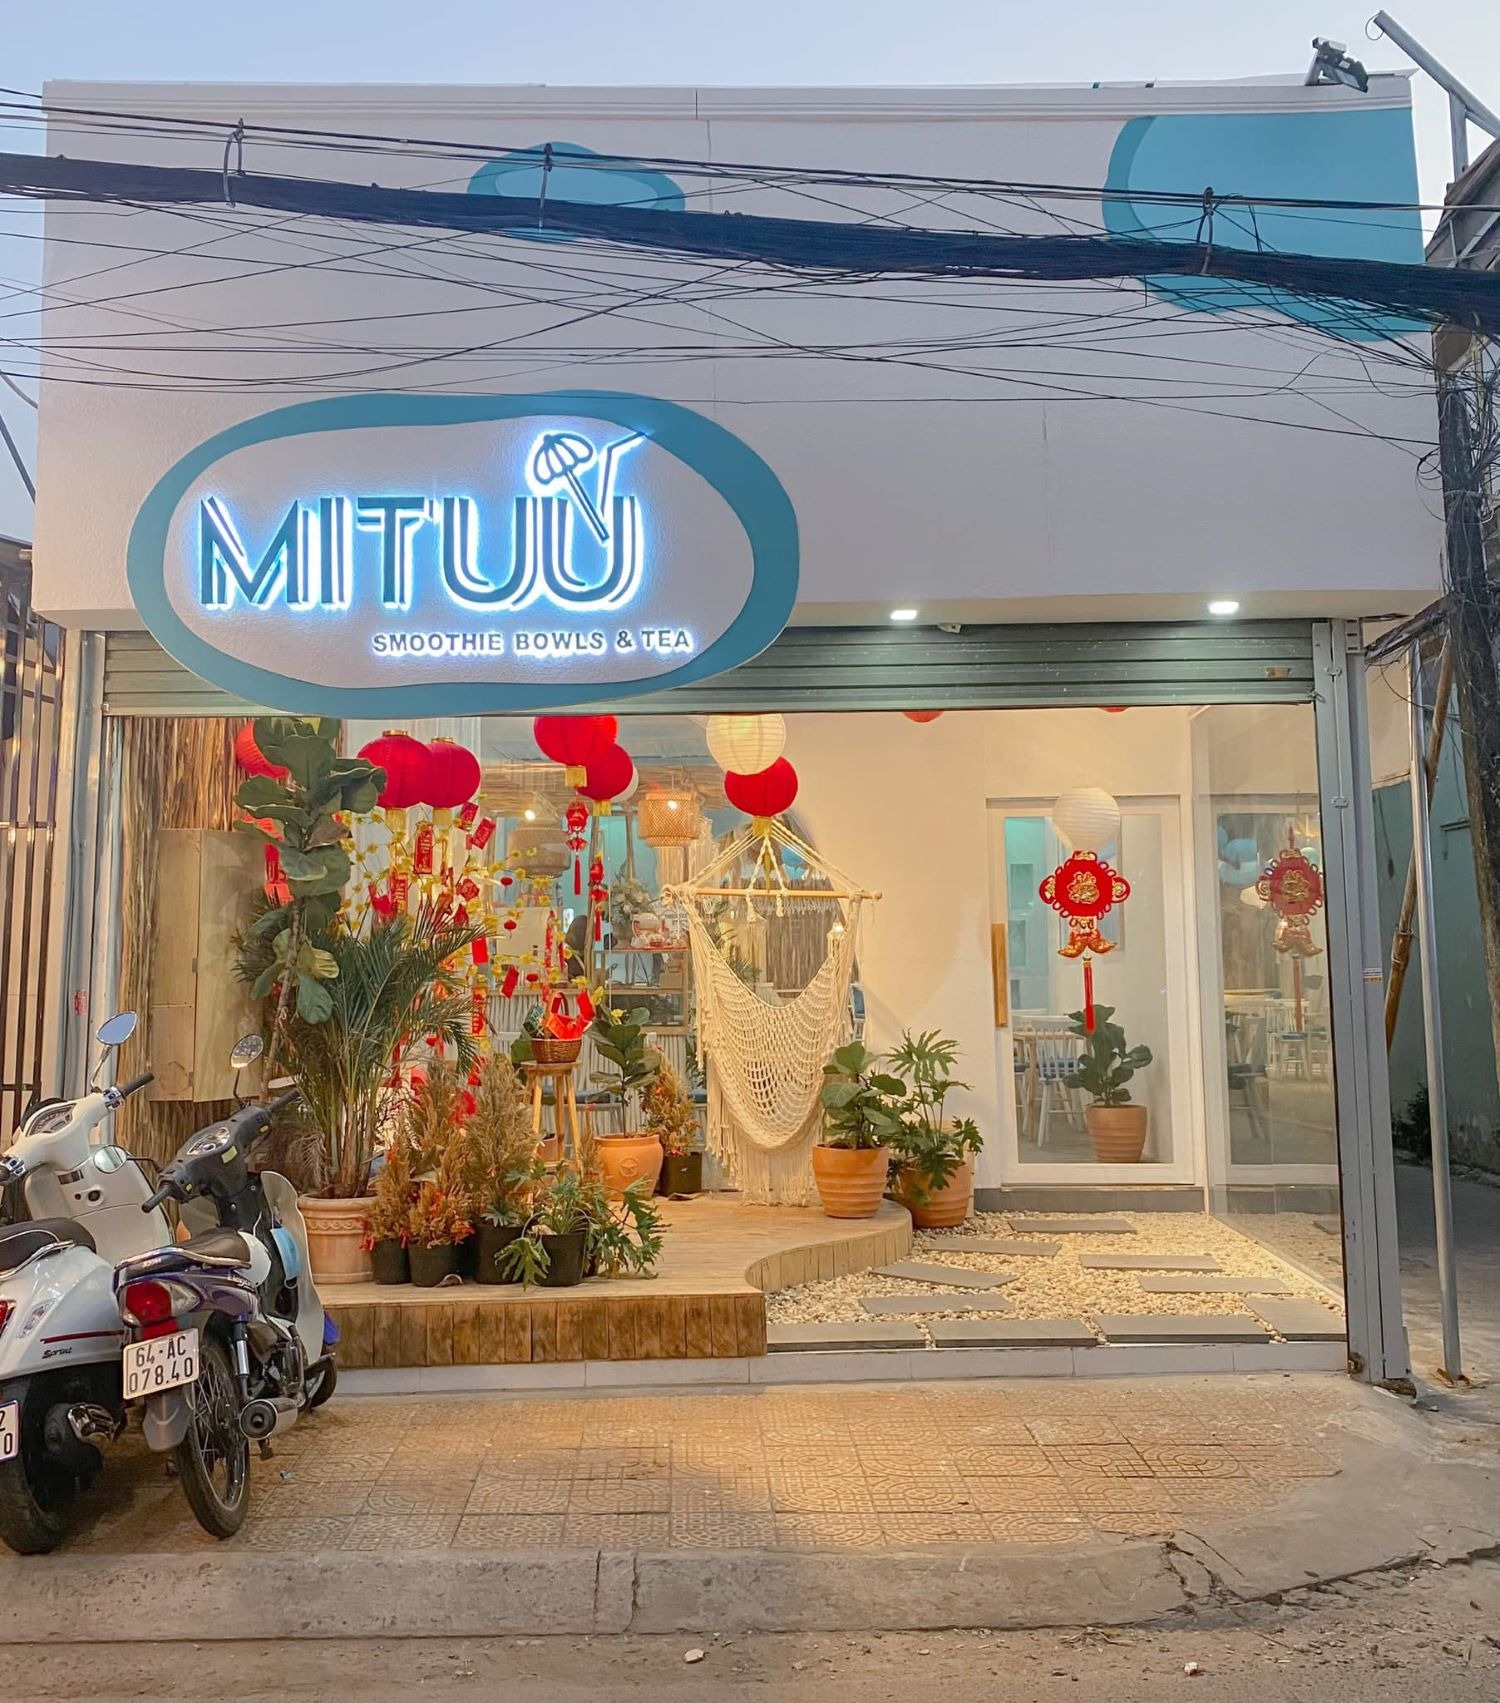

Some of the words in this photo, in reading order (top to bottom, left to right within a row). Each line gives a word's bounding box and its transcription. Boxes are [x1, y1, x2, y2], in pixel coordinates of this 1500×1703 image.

[373, 632, 502, 653] SMOOTHIE
[515, 631, 604, 651] BOWLS
[616, 630, 633, 648] &
[641, 629, 691, 648] TEA
[129, 1357, 193, 1393] 078.40
